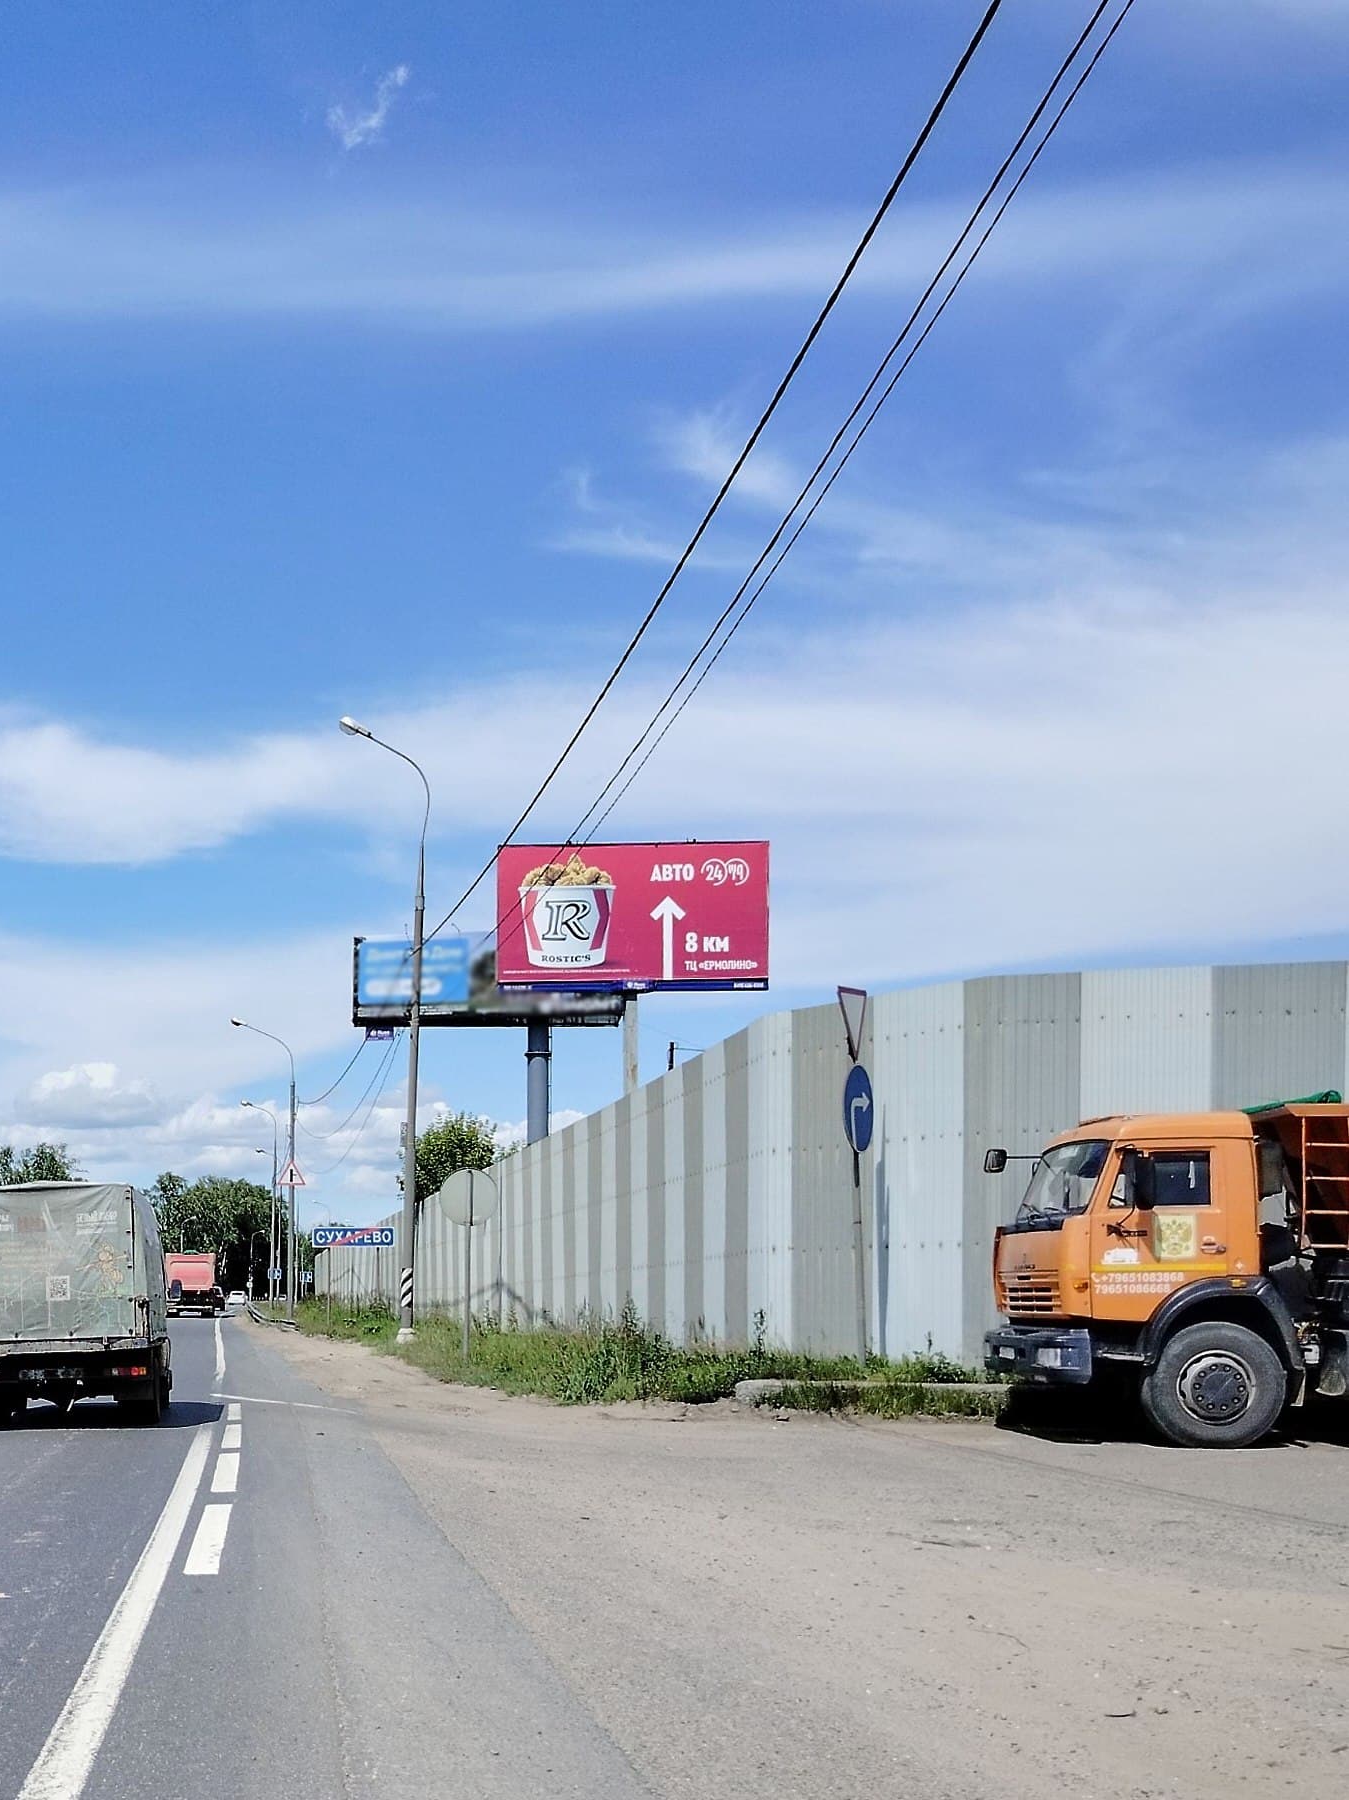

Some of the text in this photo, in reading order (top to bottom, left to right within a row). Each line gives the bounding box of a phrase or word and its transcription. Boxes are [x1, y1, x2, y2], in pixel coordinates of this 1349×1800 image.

[650, 863, 694, 881] АВТО
[685, 932, 698, 952] 8
[541, 954, 591, 963] ROSTIC'S
[684, 961, 697, 972] ТЦ
[316, 1231, 392, 1243] СУХАРЕВО
